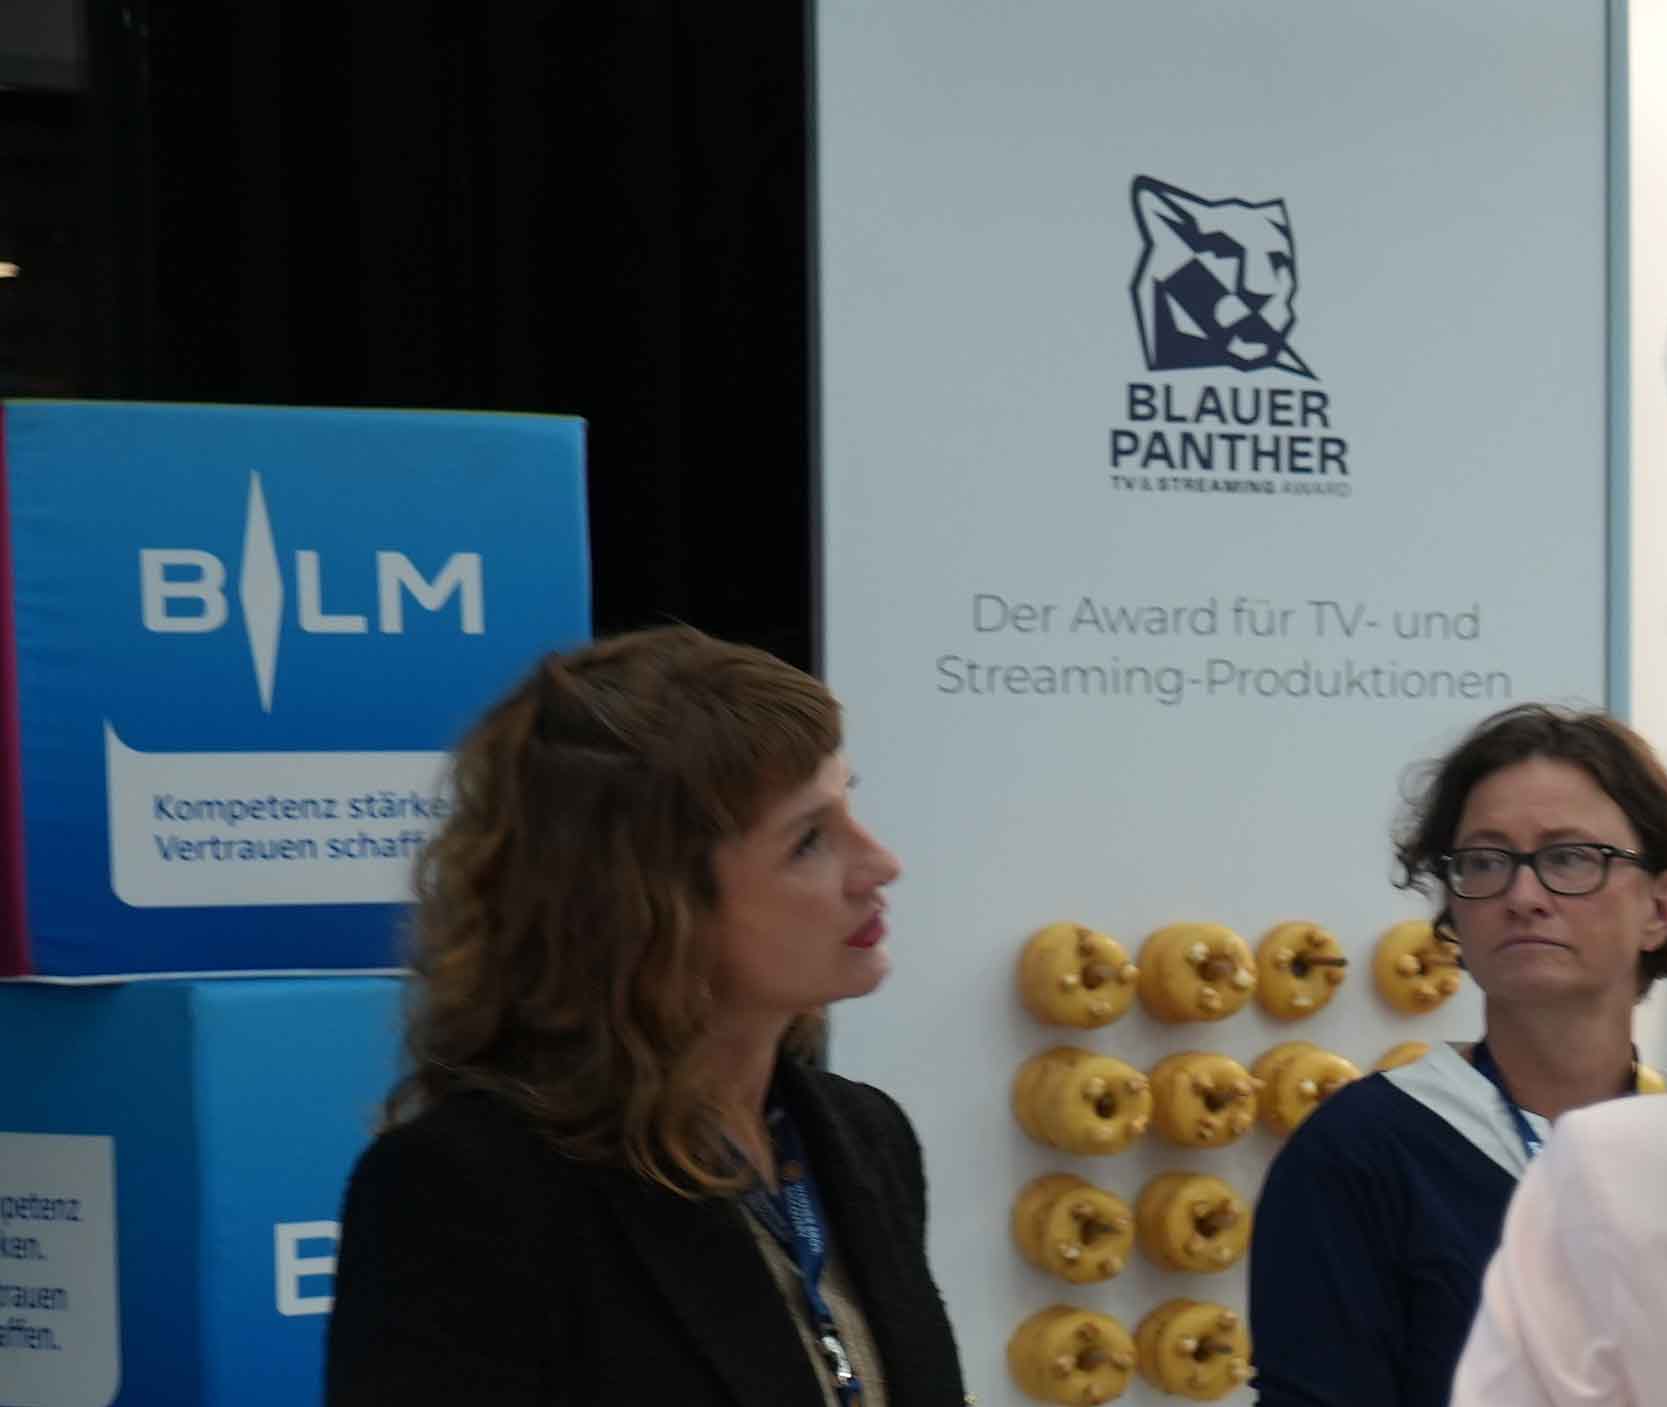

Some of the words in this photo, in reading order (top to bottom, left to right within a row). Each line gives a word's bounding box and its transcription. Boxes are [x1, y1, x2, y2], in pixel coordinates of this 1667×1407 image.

[1128, 384, 1331, 428] BLAUER
[1110, 430, 1349, 475] PANTHER
[1110, 474, 1137, 492] TV
[1156, 475, 1277, 494] STREAMING
[972, 593, 1055, 635] Der
[1070, 595, 1217, 639] Award
[1232, 597, 1293, 639] für
[1307, 600, 1379, 641] TV-
[1392, 602, 1481, 642] und
[935, 654, 1512, 706] Streaming-Produktionen
[154, 793, 340, 828] Kompetenz
[348, 791, 450, 820] stärke
[154, 834, 318, 862] Vertrauen
